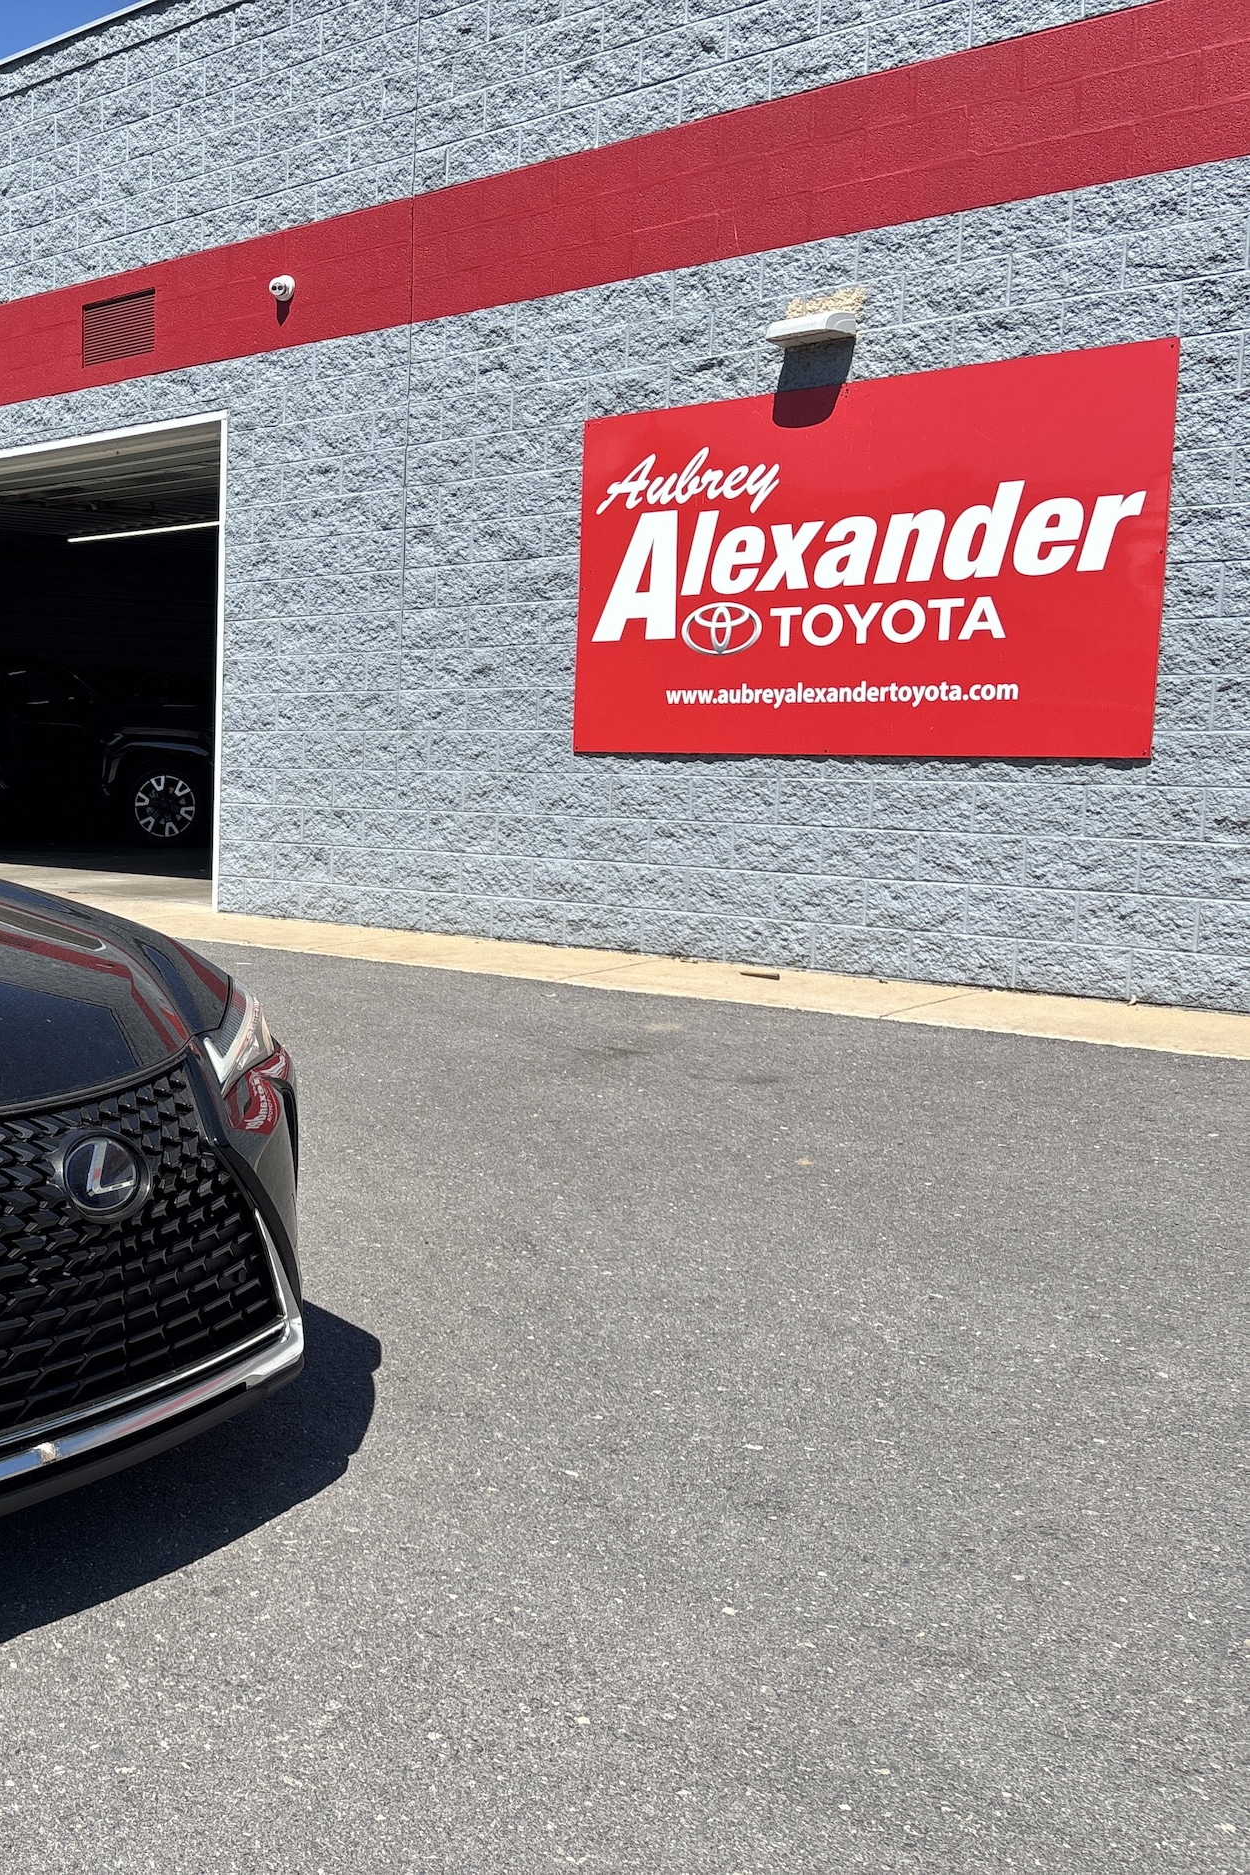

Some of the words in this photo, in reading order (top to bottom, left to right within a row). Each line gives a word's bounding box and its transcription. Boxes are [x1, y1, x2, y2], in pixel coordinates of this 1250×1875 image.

[595, 446, 781, 515] Aubrey
[591, 480, 1147, 644] Alexander
[769, 596, 1006, 648] TOYOTA
[665, 680, 1019, 709] www.aubreyalexandertoyota.com
